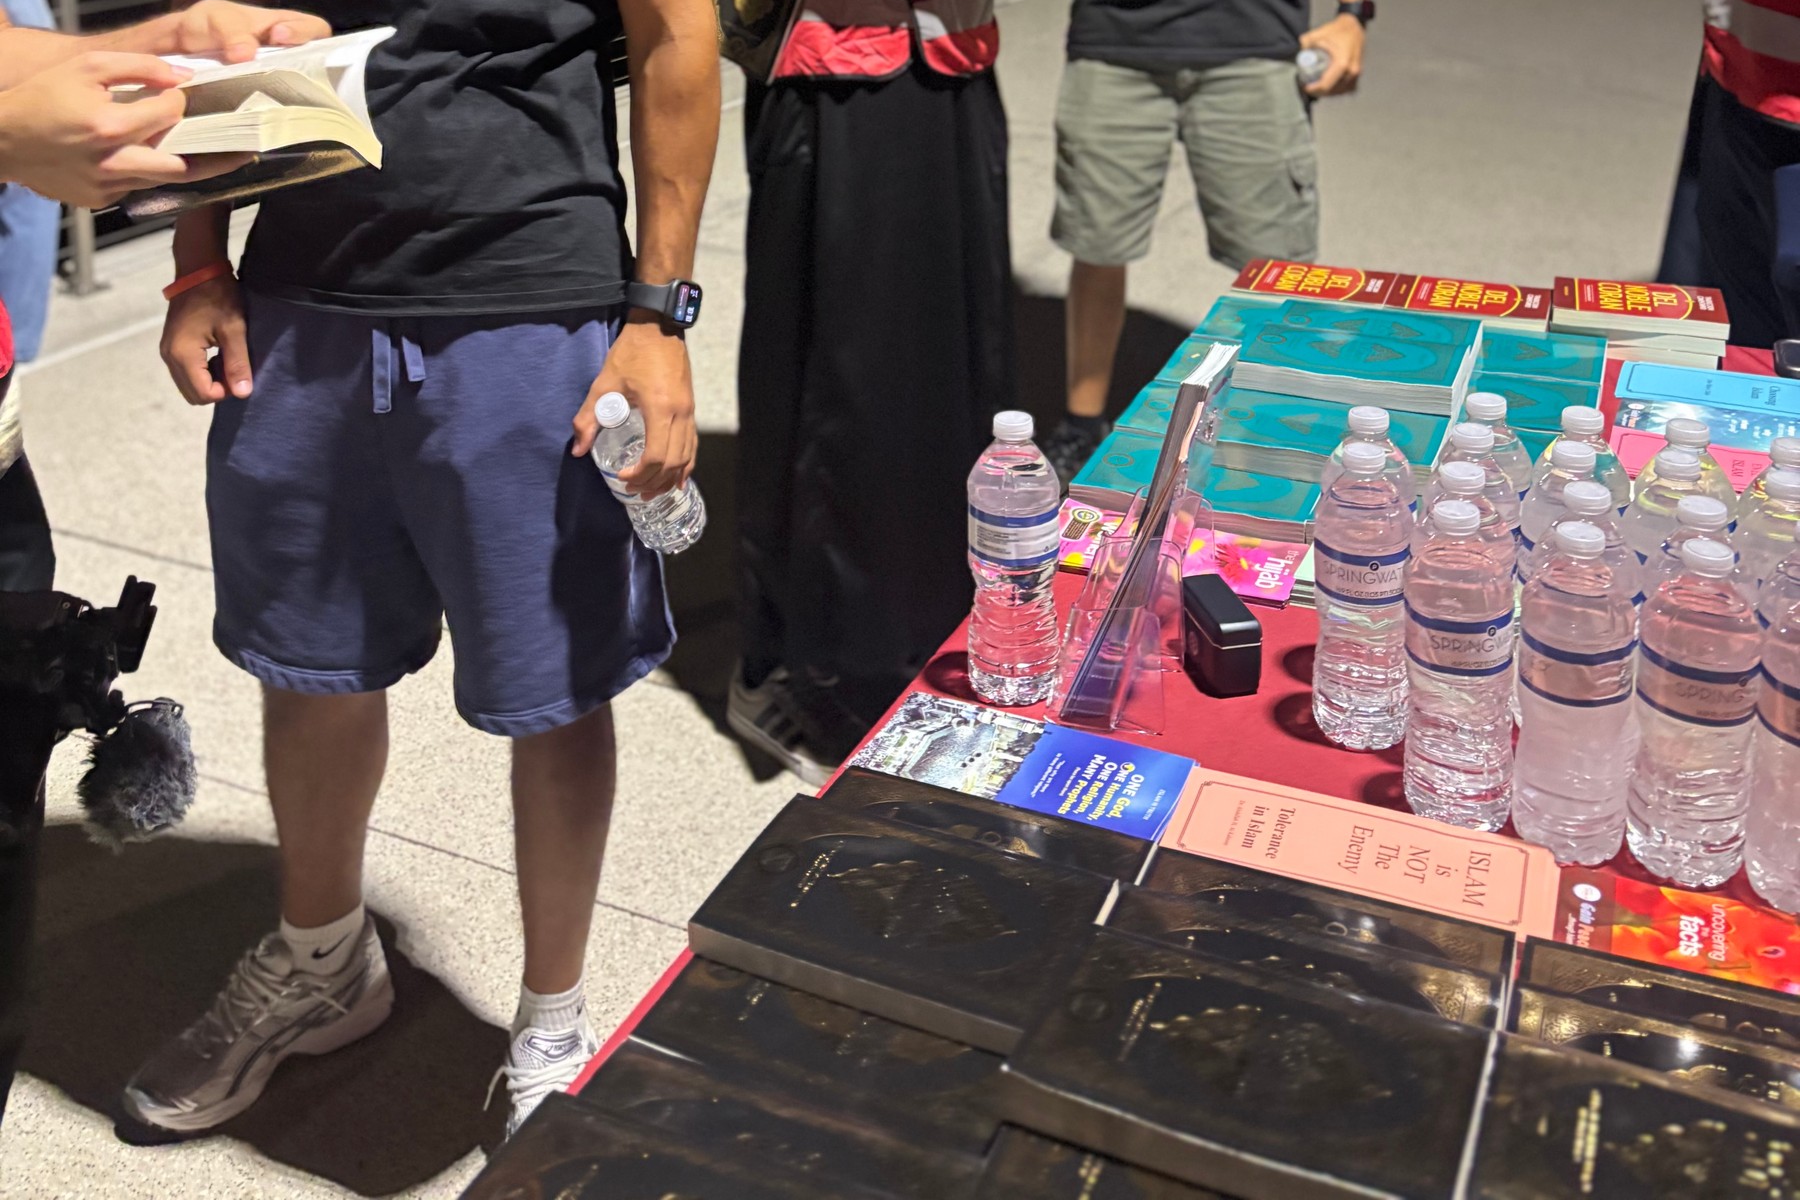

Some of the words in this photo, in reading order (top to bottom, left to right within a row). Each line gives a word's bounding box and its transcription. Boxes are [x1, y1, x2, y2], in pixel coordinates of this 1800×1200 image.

[1276, 265, 1305, 291] CORAN
[1298, 267, 1330, 294] NOBLE
[1328, 273, 1351, 290] DEL
[1430, 280, 1457, 308] CORAN
[1456, 283, 1484, 309] NOBLE
[1484, 289, 1507, 304] DEL
[1598, 282, 1623, 311] CORAN
[1625, 285, 1651, 312] NOBLE
[1652, 291, 1677, 308] DEL
[1254, 557, 1293, 589] hijab
[1081, 754, 1107, 780] MANY
[1097, 761, 1118, 782] ONE
[1057, 780, 1088, 815] Prophets
[1073, 781, 1104, 814] Religion,
[1122, 773, 1145, 797] ONE
[1086, 782, 1121, 821] Humanity,
[1106, 797, 1132, 818] God,
[1252, 805, 1270, 818] in
[1241, 818, 1267, 849] Islam
[1265, 807, 1297, 860] Tolerance
[1337, 825, 1374, 876] Enemy
[1374, 843, 1401, 871] The
[1403, 845, 1431, 885] NOT
[1435, 864, 1458, 878] is
[1462, 850, 1492, 908] ISLAM
[1679, 915, 1705, 957] facts
[1707, 903, 1727, 961] uncovering
